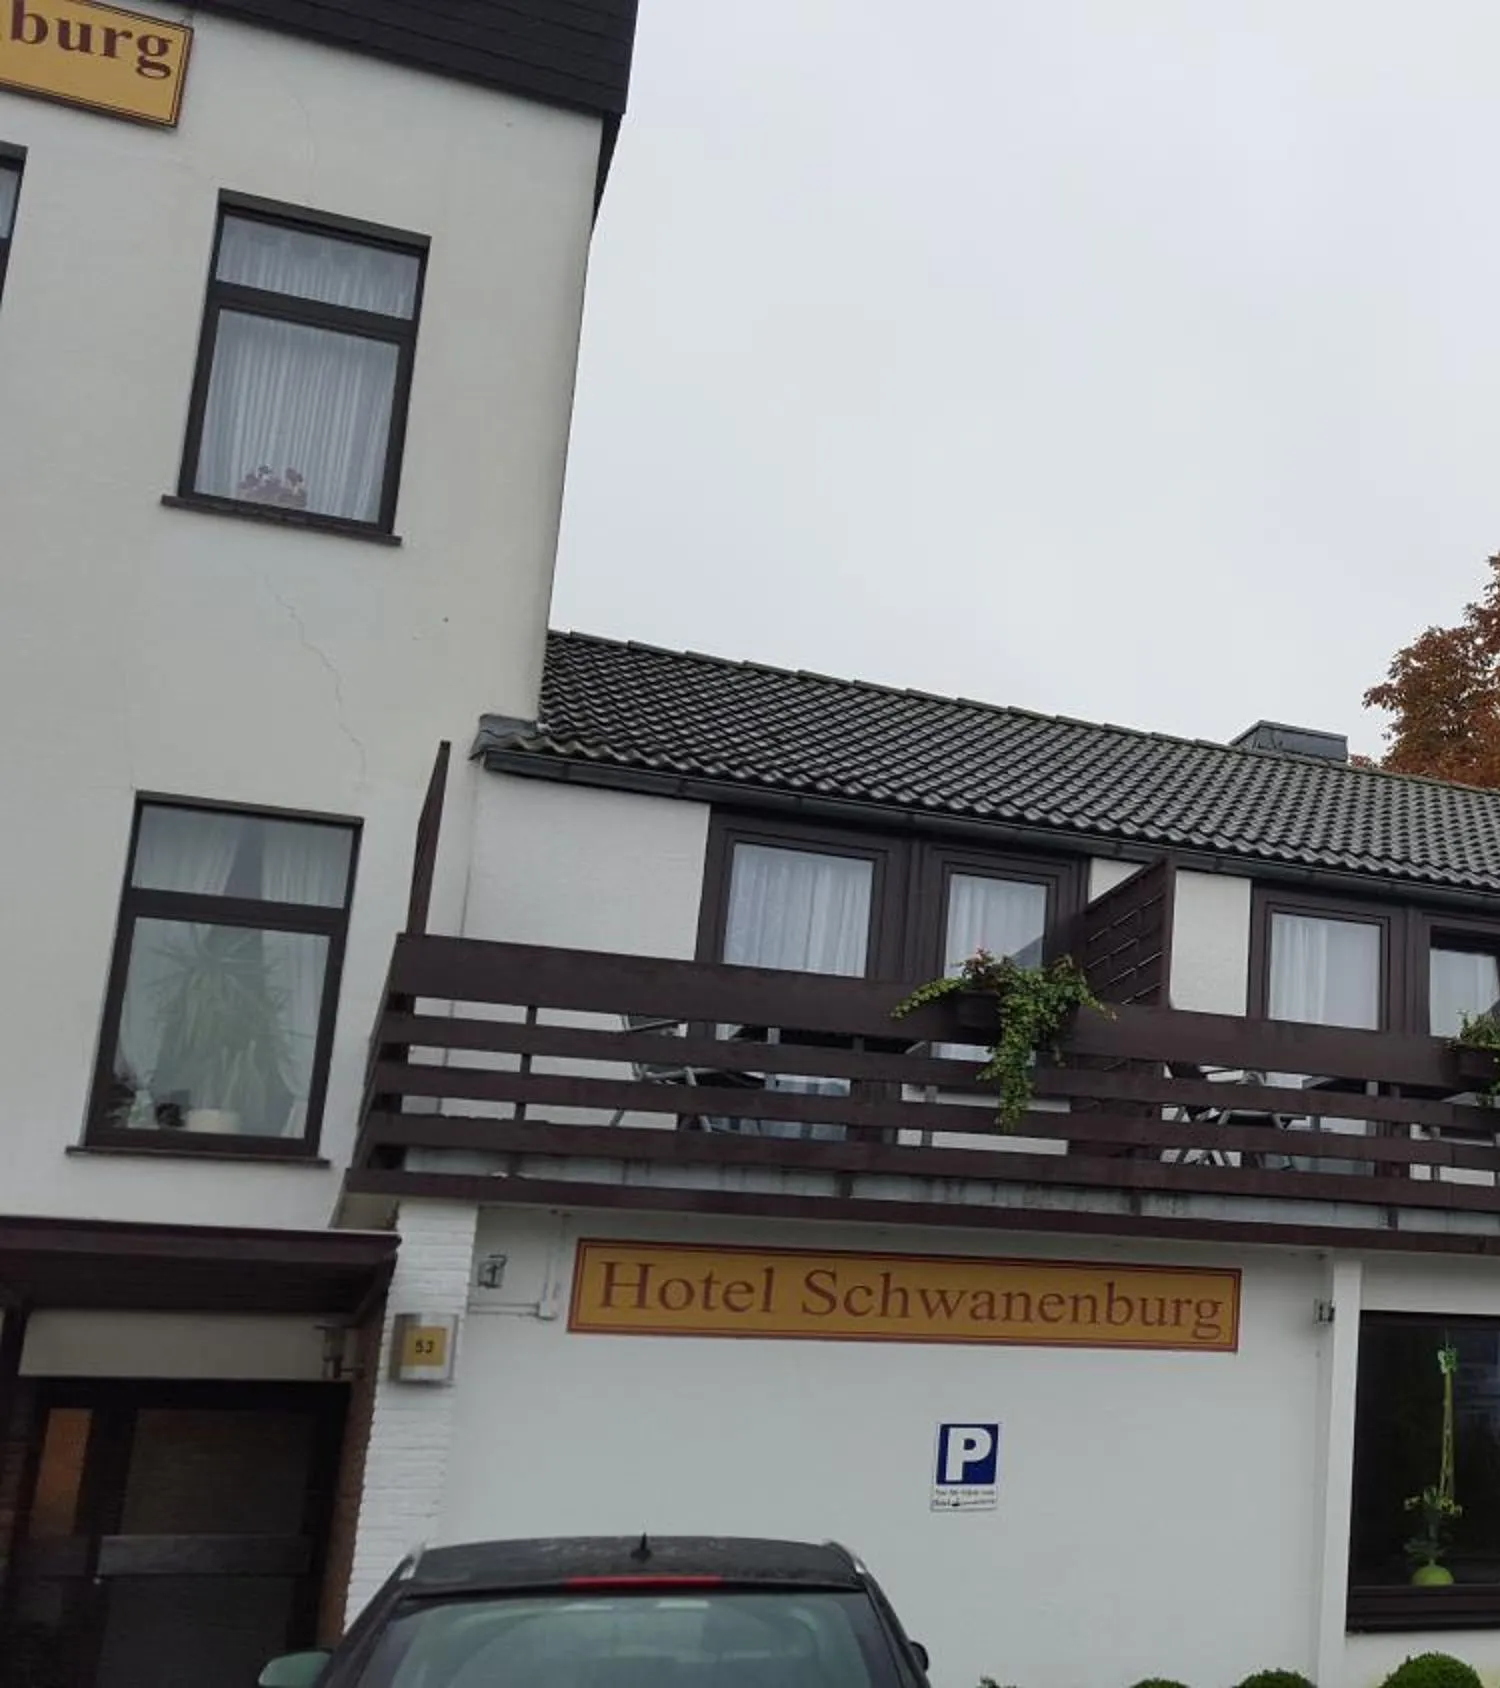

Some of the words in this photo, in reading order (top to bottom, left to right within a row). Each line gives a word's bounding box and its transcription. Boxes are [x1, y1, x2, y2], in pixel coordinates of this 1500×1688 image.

[599, 1261, 774, 1314] Hotel
[802, 1269, 1223, 1339] Schwanenburg
[945, 1427, 992, 1481] P
